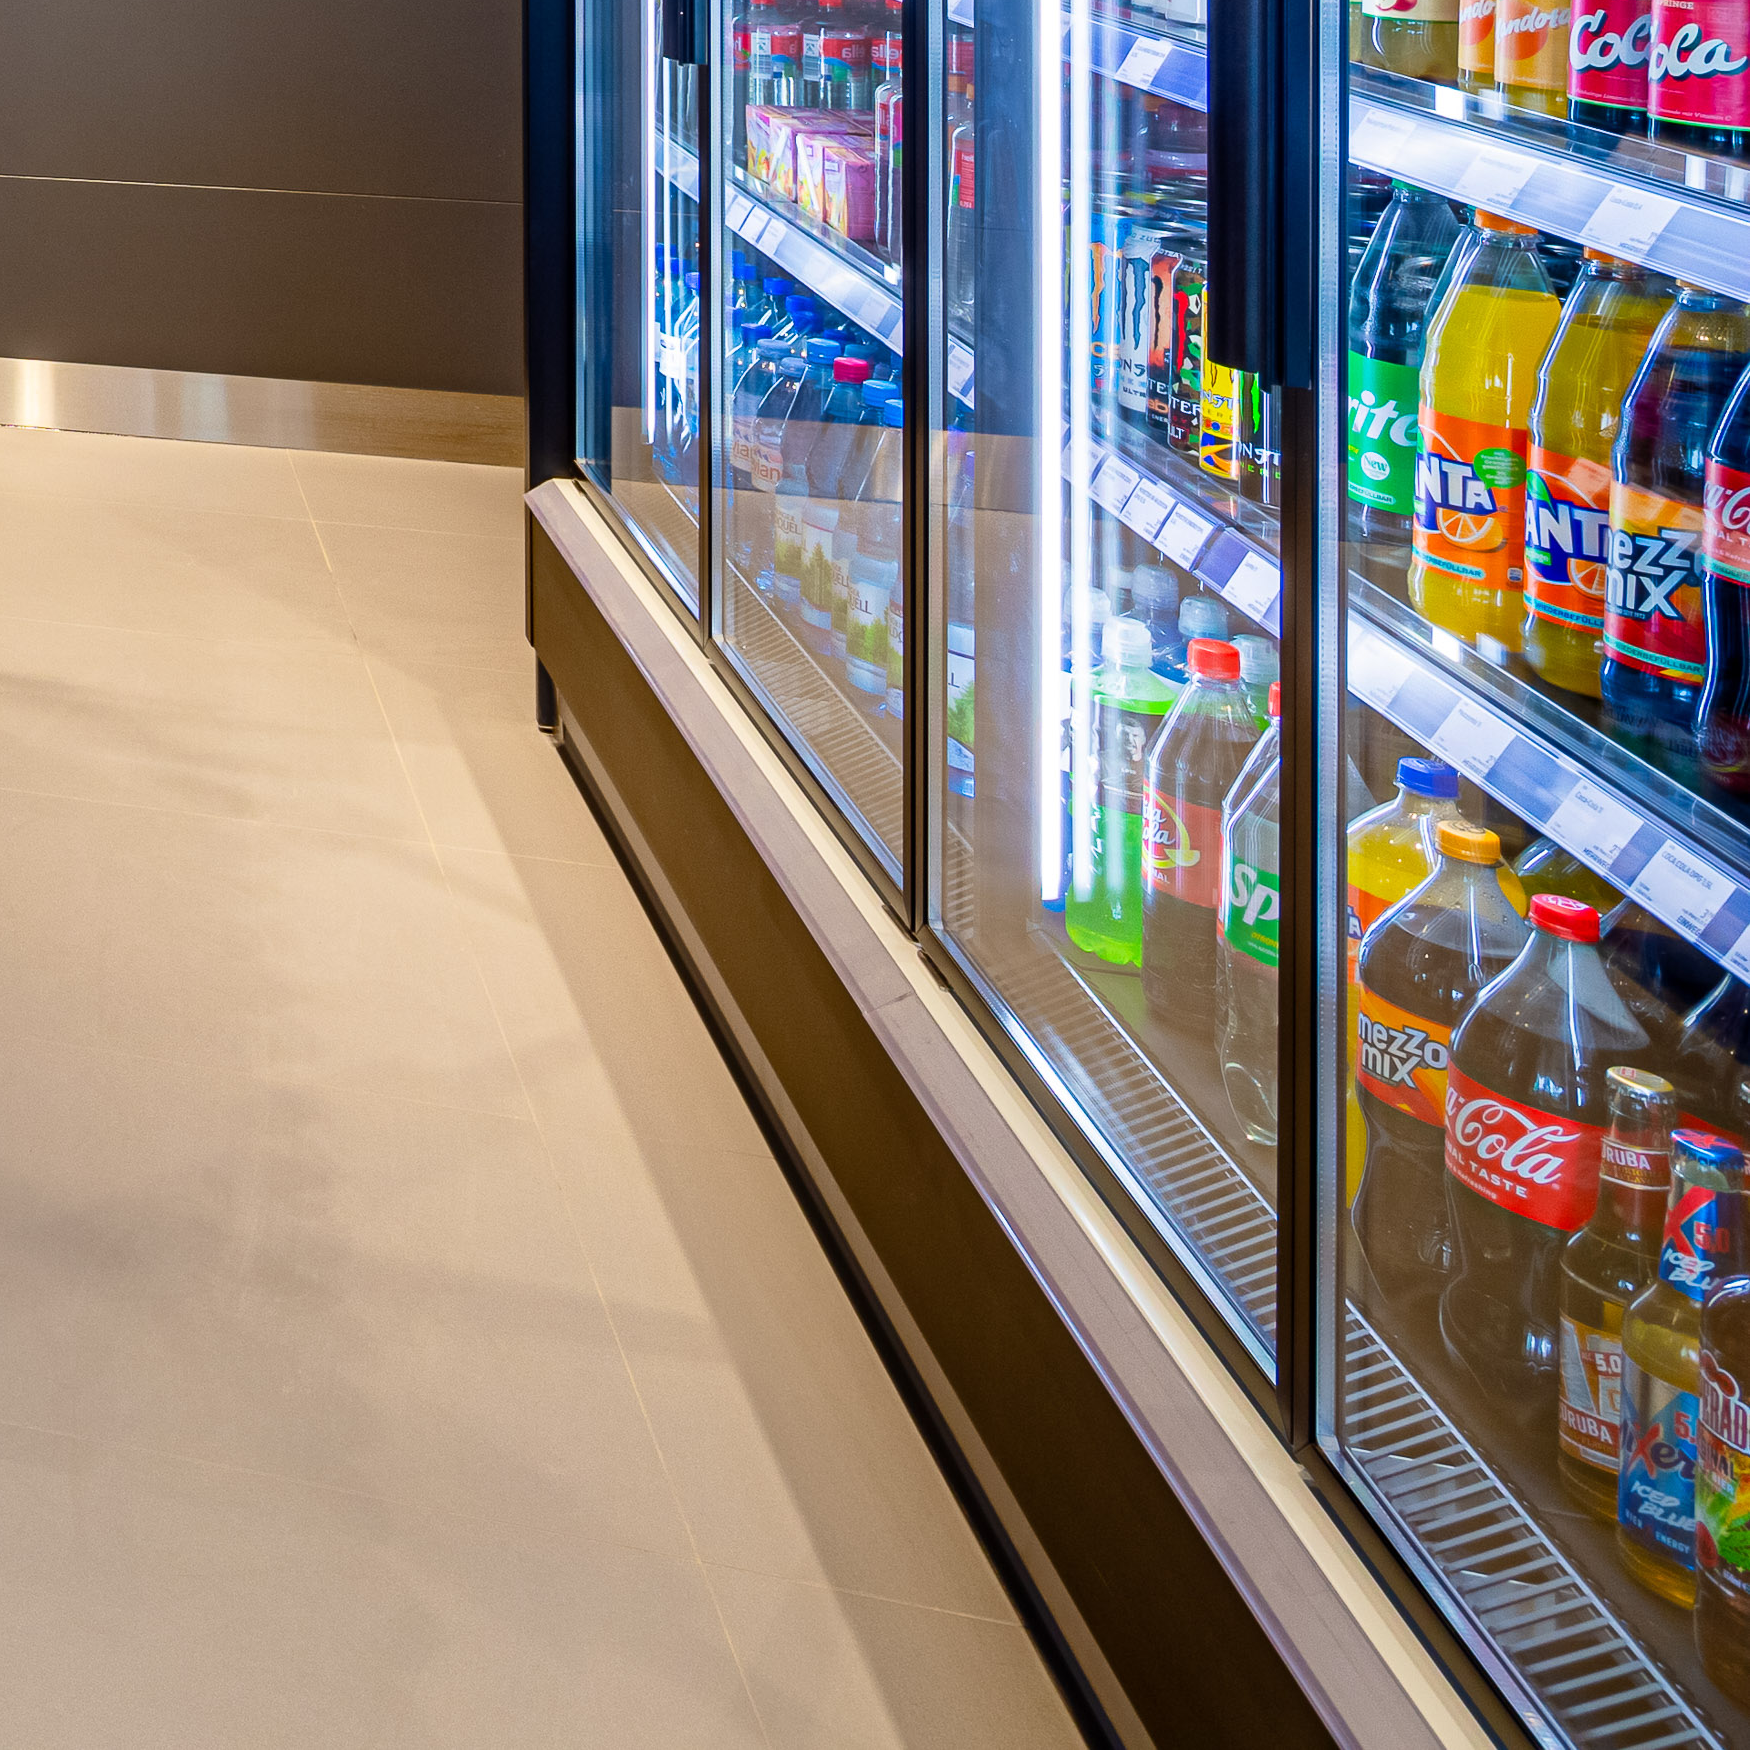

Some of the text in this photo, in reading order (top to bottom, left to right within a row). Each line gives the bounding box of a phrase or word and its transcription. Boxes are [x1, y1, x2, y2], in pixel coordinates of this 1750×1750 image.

[1363, 454, 1388, 474] New
[1359, 1012, 1448, 1069] mezzo
[1362, 1043, 1421, 1088] mix
[1470, 1161, 1528, 1198] TASTE
[1664, 1247, 1715, 1273] ICED
[1631, 1480, 1680, 1508] ICED
[1638, 1500, 1697, 1532] BLUE
[1655, 1529, 1691, 1556] ENERGY
